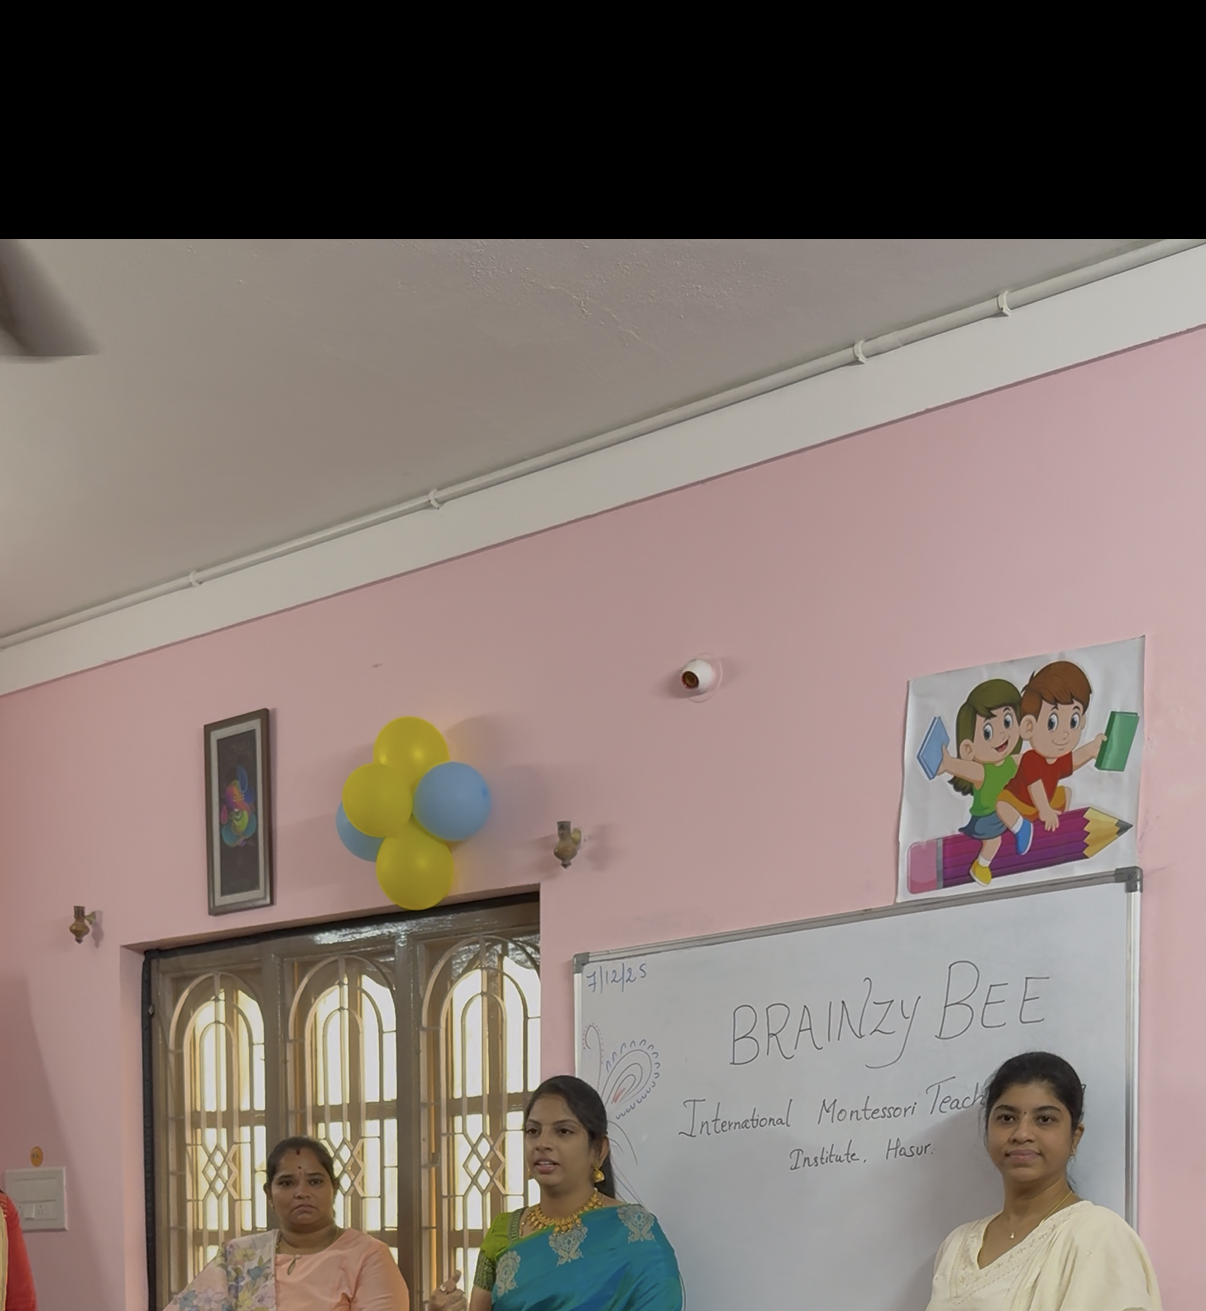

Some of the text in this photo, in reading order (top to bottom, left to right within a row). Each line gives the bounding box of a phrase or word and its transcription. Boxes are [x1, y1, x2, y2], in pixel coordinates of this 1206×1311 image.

[585, 962, 648, 994] 7/12/25
[729, 960, 1051, 1070] BRAINZY BEE
[678, 1076, 987, 1138] International Montessori Teach
